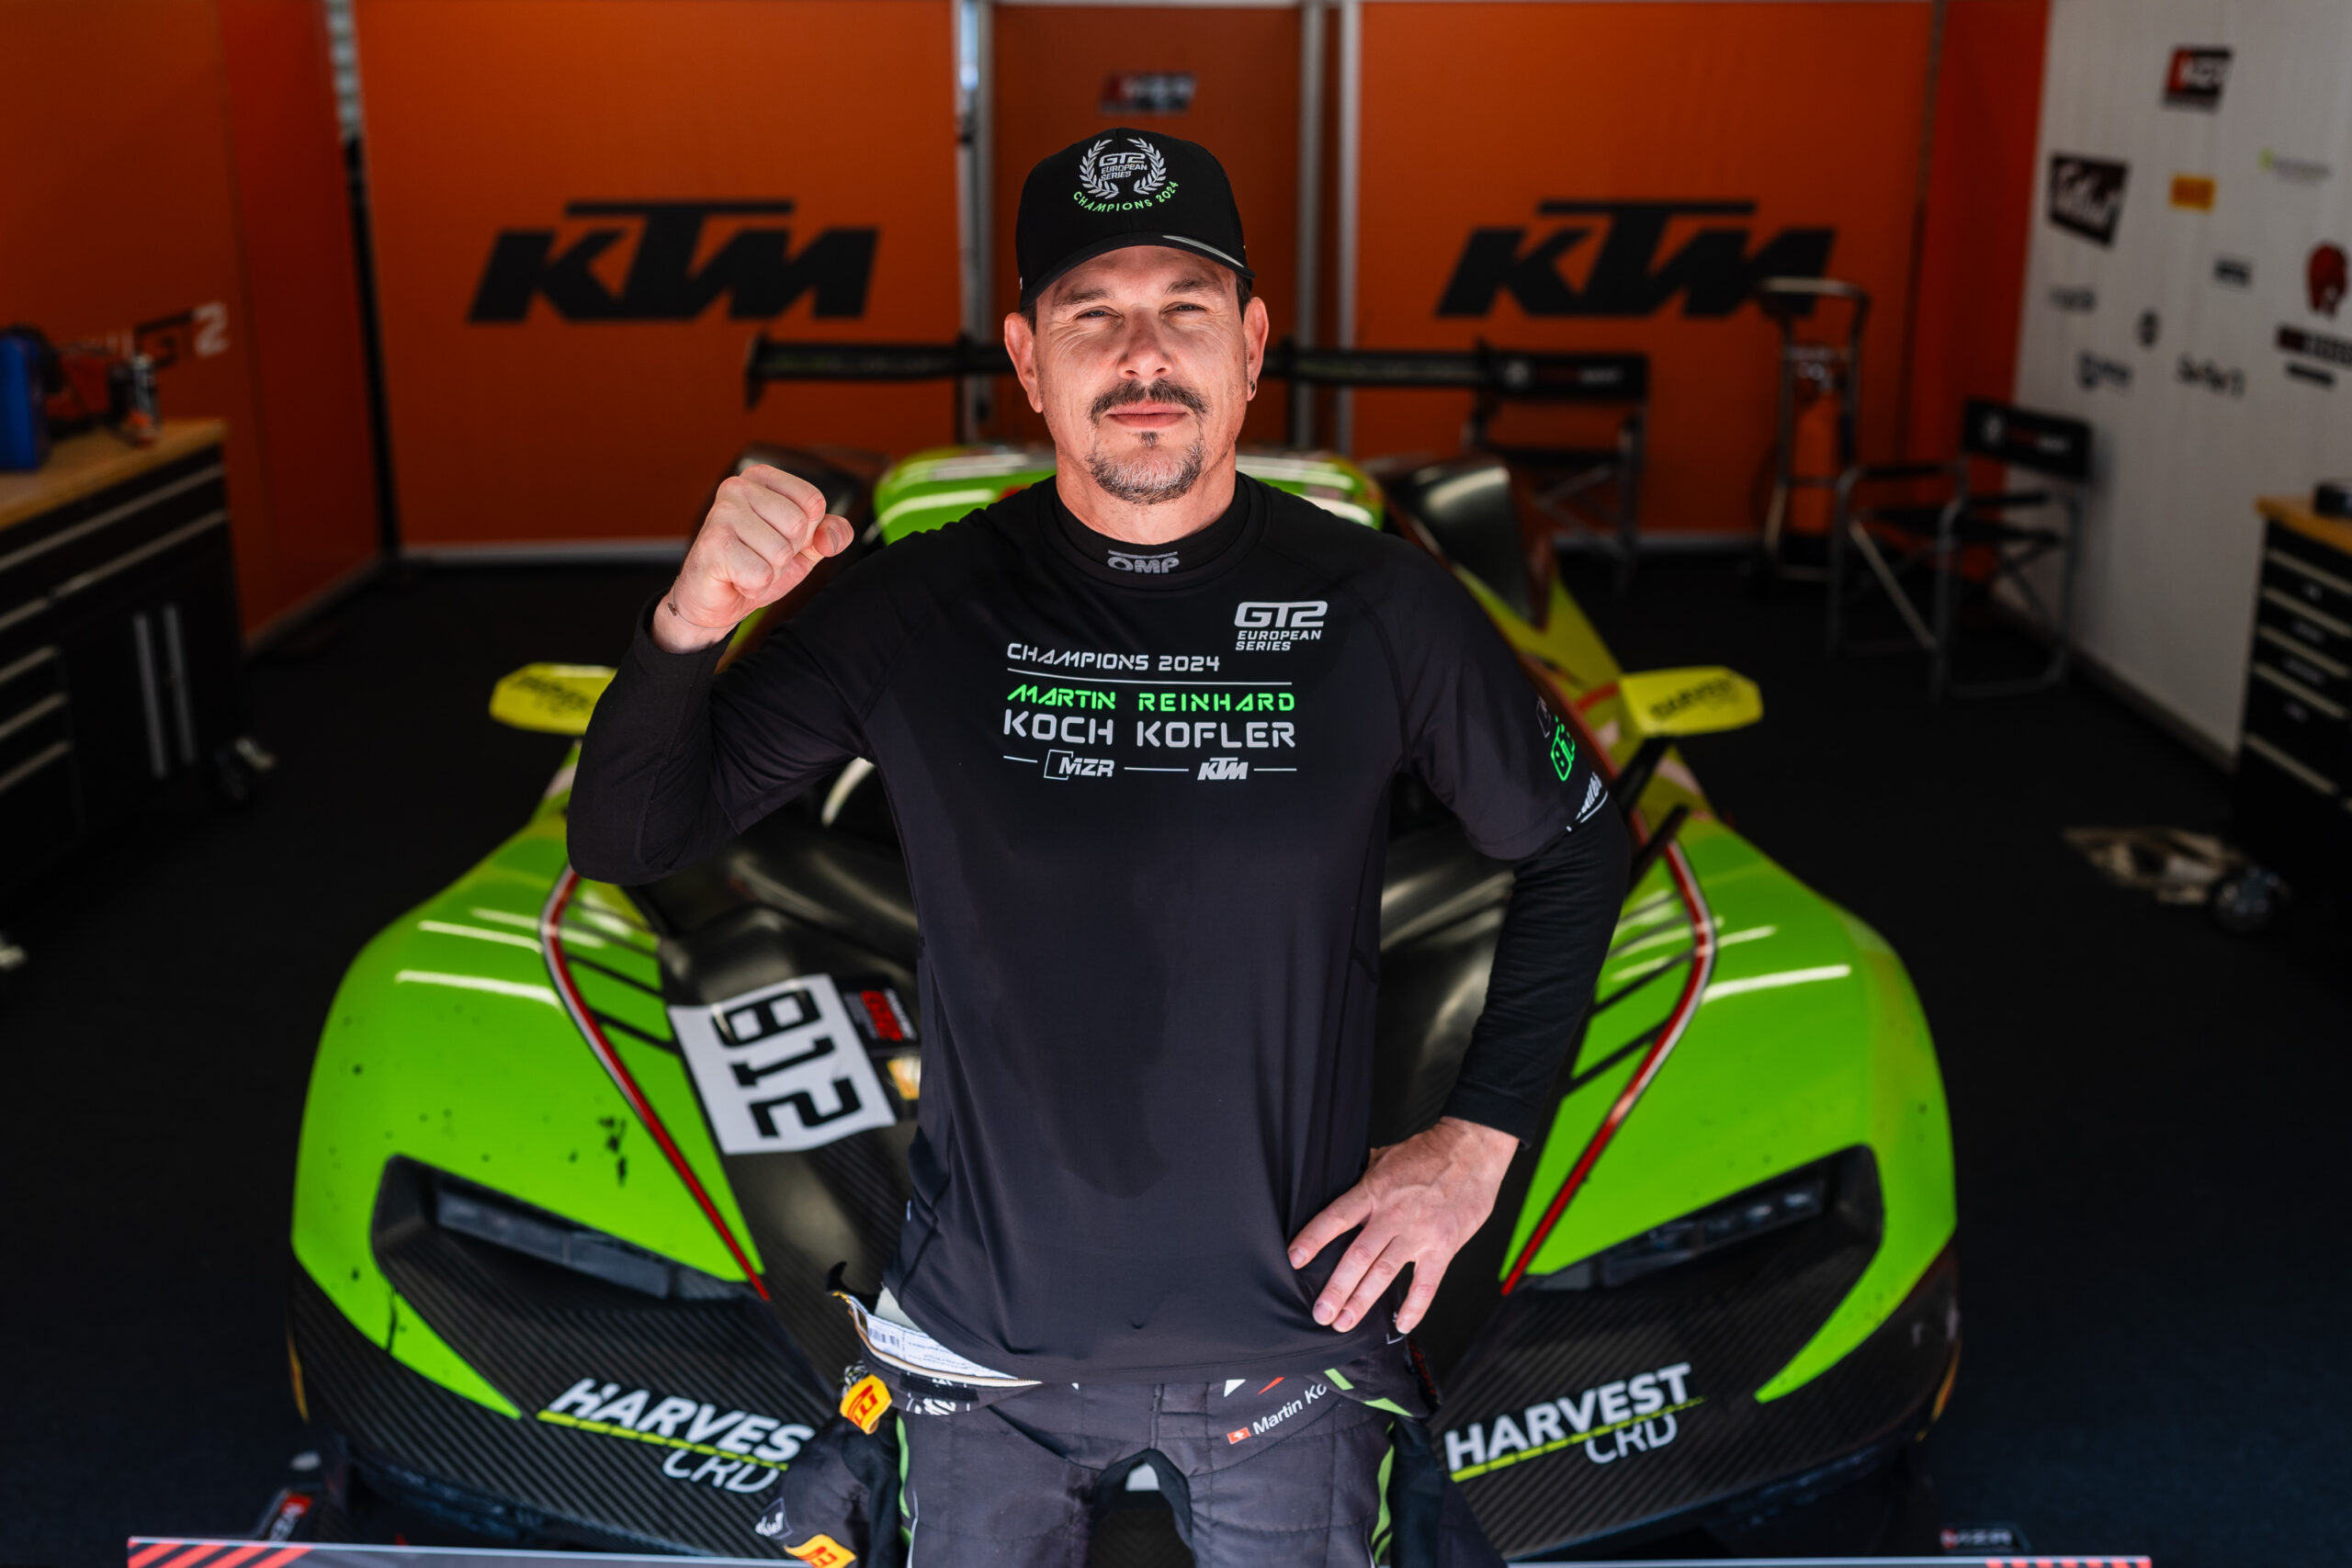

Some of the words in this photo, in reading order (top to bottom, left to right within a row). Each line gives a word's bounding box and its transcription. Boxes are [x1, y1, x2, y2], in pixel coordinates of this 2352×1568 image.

[1099, 152, 1146, 167] GT2
[1101, 164, 1148, 175] EUROPEAN
[1101, 171, 1131, 181] SERIES
[1073, 191, 1152, 212] CHAMPIONS
[1156, 181, 1179, 202] 2024
[467, 200, 879, 323] KTM
[1435, 199, 1837, 318] KTM
[1107, 554, 1180, 574] OMP
[1234, 601, 1329, 628] GT2
[1235, 640, 1292, 651] SERIES
[1237, 630, 1322, 641] EUROPEAN
[1007, 642, 1149, 671] CHAMPIONS
[1158, 655, 1220, 672] 2024
[1006, 683, 1116, 710] MARTIN
[1138, 693, 1295, 712] REINHARD
[1003, 708, 1114, 746] KOCH
[1136, 720, 1295, 749] KOFLER
[1057, 757, 1115, 778] MZR
[1197, 757, 1249, 781] KTM
[710, 988, 862, 1138] 812
[549, 1378, 816, 1462] HARVES
[1252, 1400, 1303, 1435] Martin
[1305, 1383, 1328, 1404] Ko
[1443, 1361, 1692, 1472] HARVEST
[1584, 1413, 1679, 1464] CRD
[662, 1448, 779, 1494] CRD
